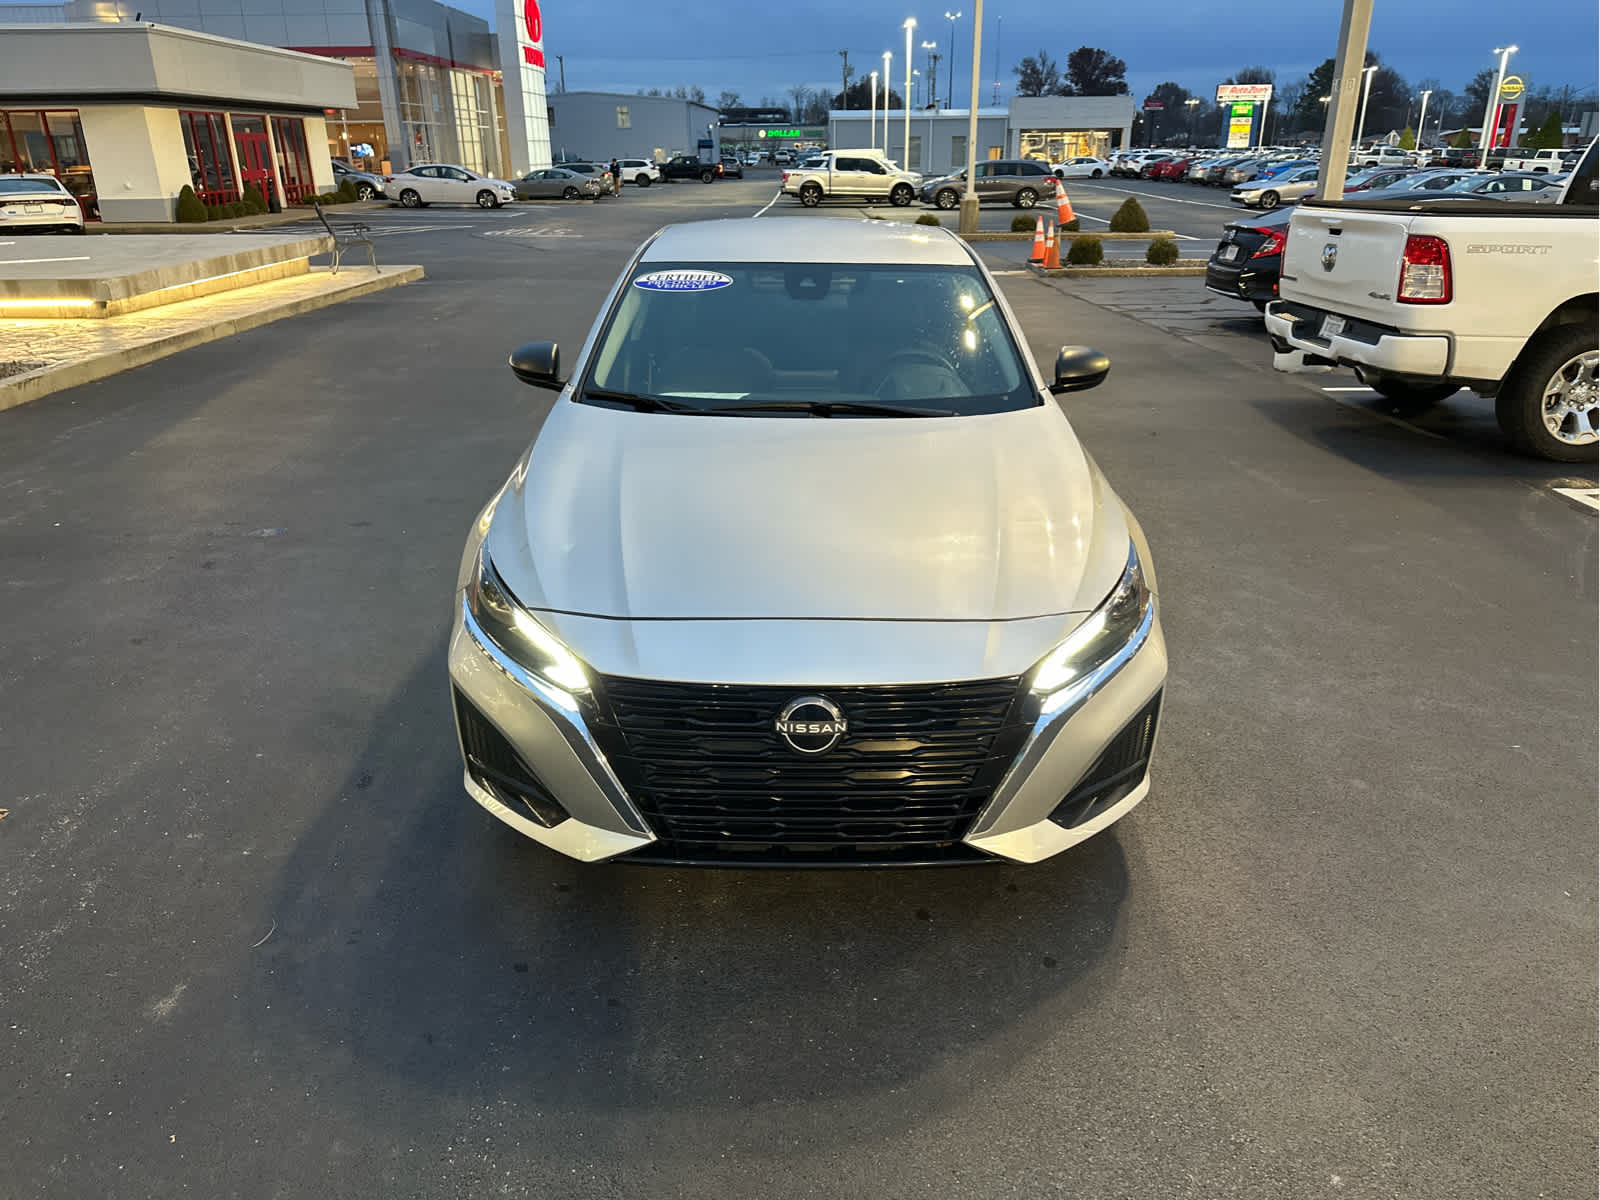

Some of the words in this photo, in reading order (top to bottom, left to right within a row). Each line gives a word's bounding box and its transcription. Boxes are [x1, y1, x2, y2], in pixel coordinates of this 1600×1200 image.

[767, 129, 800, 137] DOLLAR
[1466, 244, 1552, 254] SPORT
[776, 721, 847, 733] NISSAN
